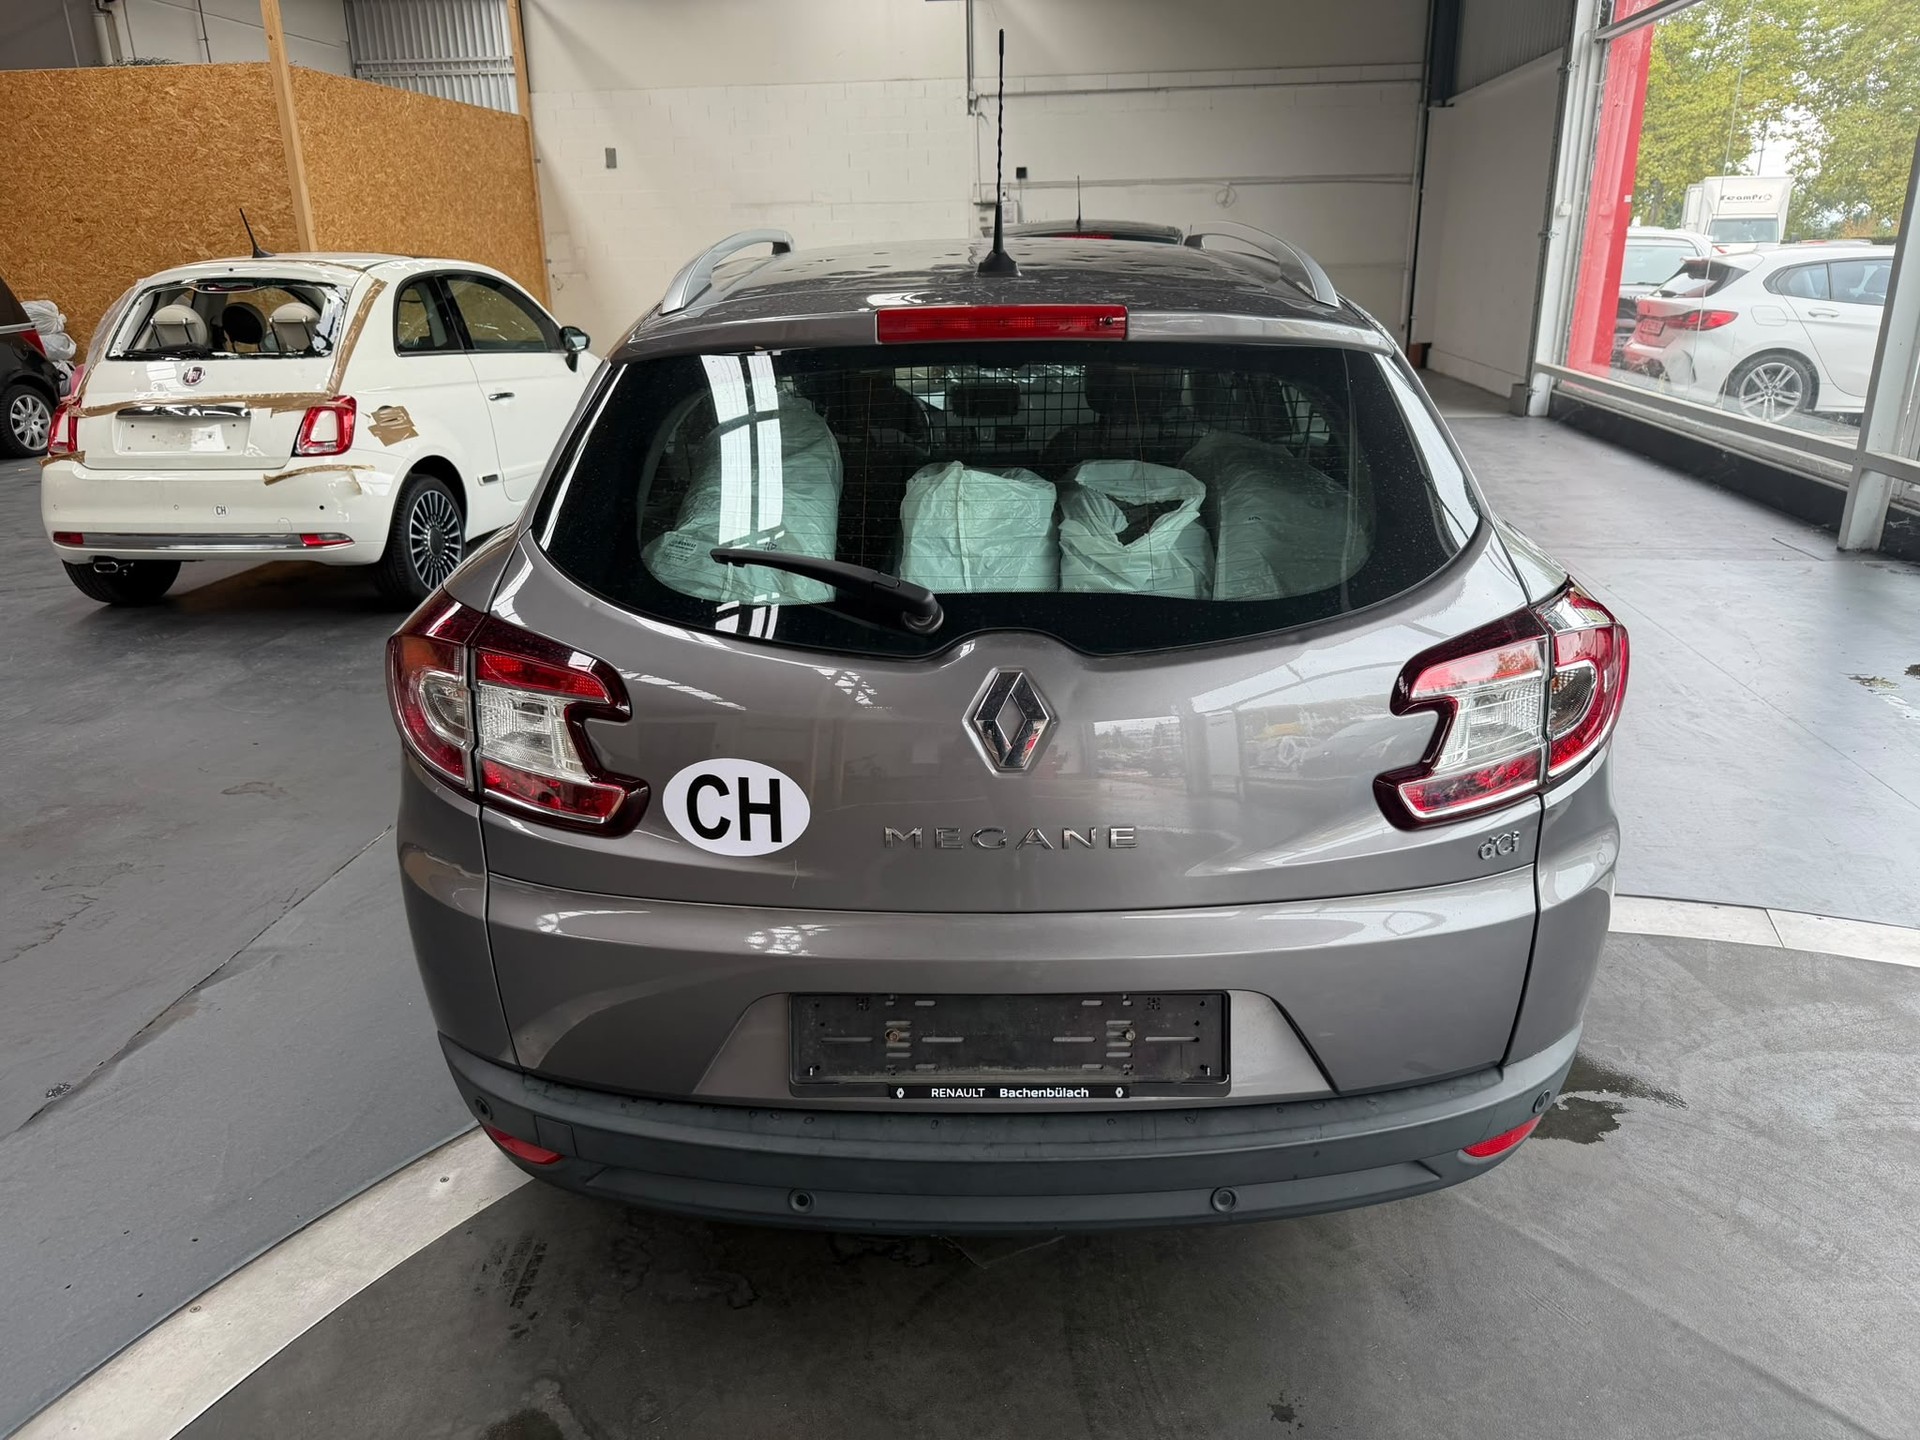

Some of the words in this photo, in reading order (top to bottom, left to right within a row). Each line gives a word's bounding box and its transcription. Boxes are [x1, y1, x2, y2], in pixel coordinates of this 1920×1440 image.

[215, 505, 227, 516] CH
[686, 773, 783, 843] CH
[884, 826, 1138, 850] MEGANE
[1478, 831, 1520, 860] dCi
[931, 1088, 986, 1098] RENAULT
[999, 1087, 1089, 1098] Bachenbülach
